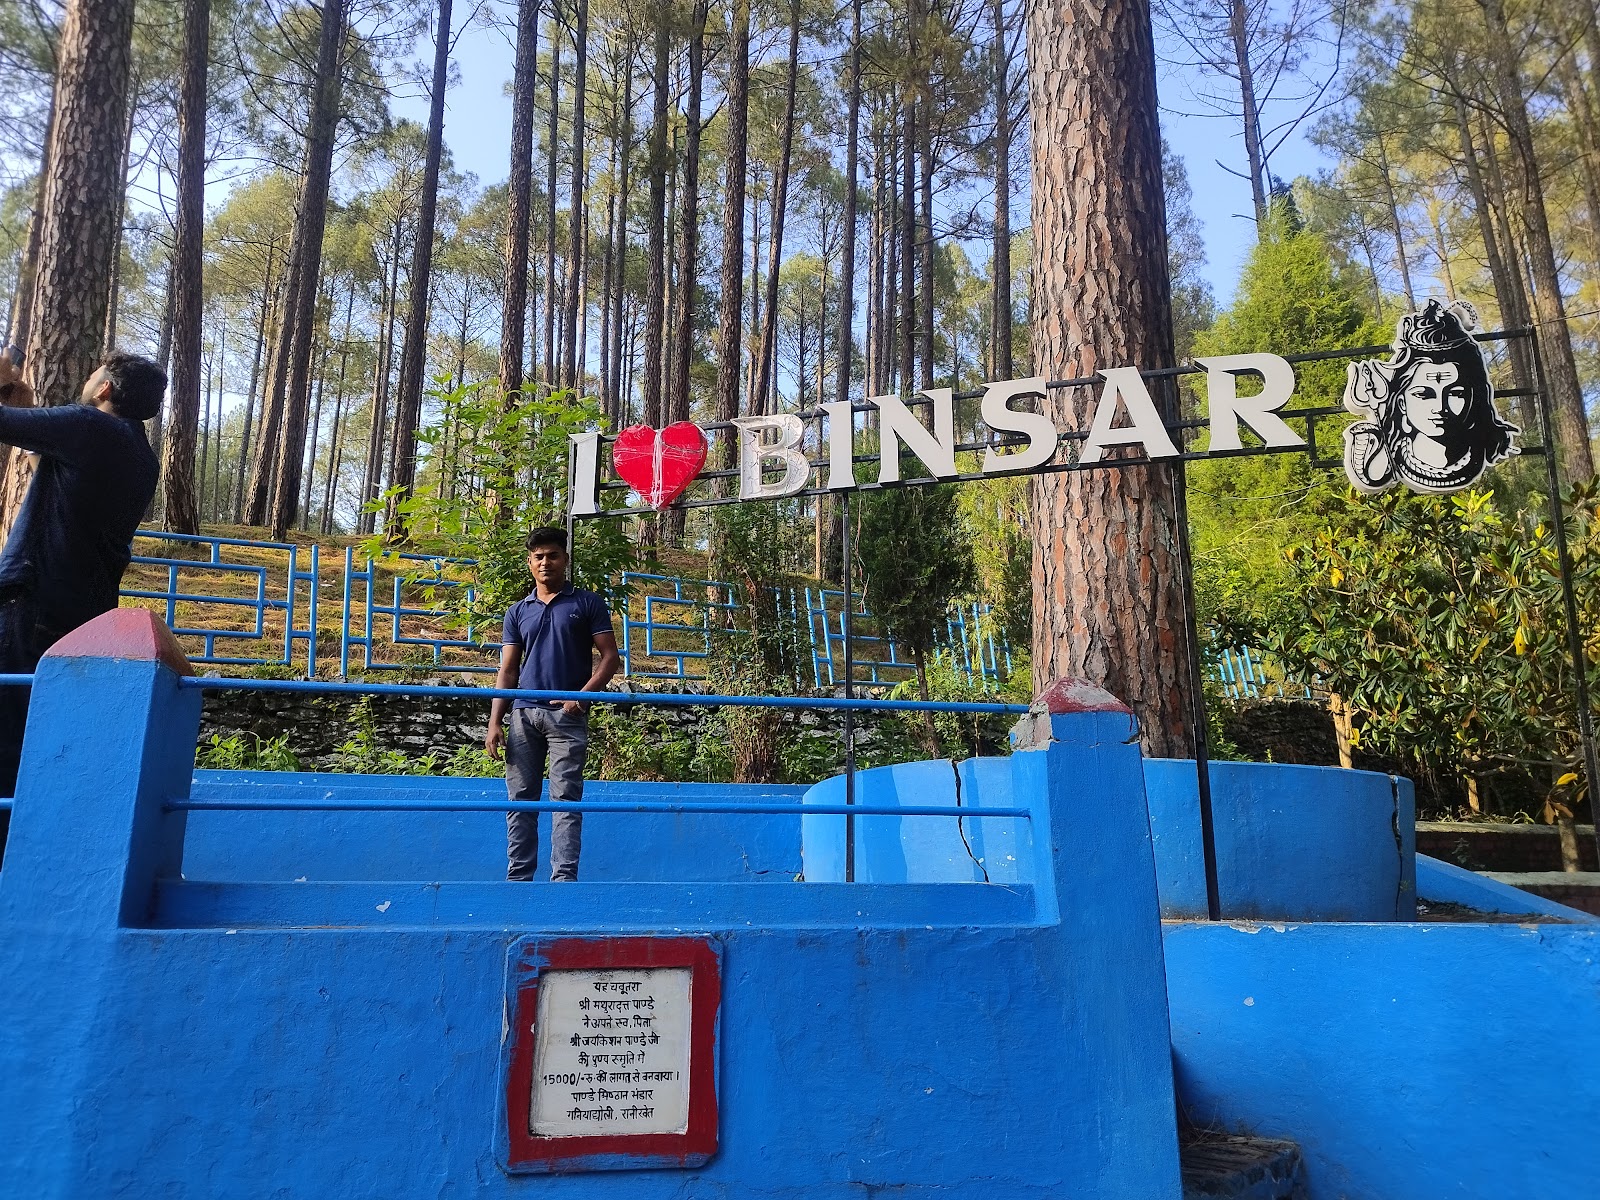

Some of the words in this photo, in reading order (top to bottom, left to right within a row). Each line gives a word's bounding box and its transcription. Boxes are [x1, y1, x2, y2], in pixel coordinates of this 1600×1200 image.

[568, 432, 600, 515] I
[730, 352, 1308, 503] BINSAR
[592, 981, 609, 993] यह
[578, 997, 590, 1011] श्री
[632, 995, 655, 1010] पाण्डे
[582, 1014, 590, 1028] ने
[591, 1014, 613, 1029] अपने
[633, 1014, 652, 1028] पिता
[570, 1032, 581, 1047] श्री
[582, 1033, 622, 1047] जयकिशन
[625, 1031, 647, 1047] पाण्डे
[648, 1031, 661, 1045] जी
[578, 1051, 589, 1067] की
[592, 1054, 609, 1067] पुण्य
[611, 1050, 635, 1068] स्मृति
[609, 1072, 632, 1084] लागत
[632, 1068, 641, 1083] से
[571, 1087, 597, 1103] पाण्डे
[631, 1087, 654, 1100] भंडार
[620, 1104, 655, 1119] रानीखेत
